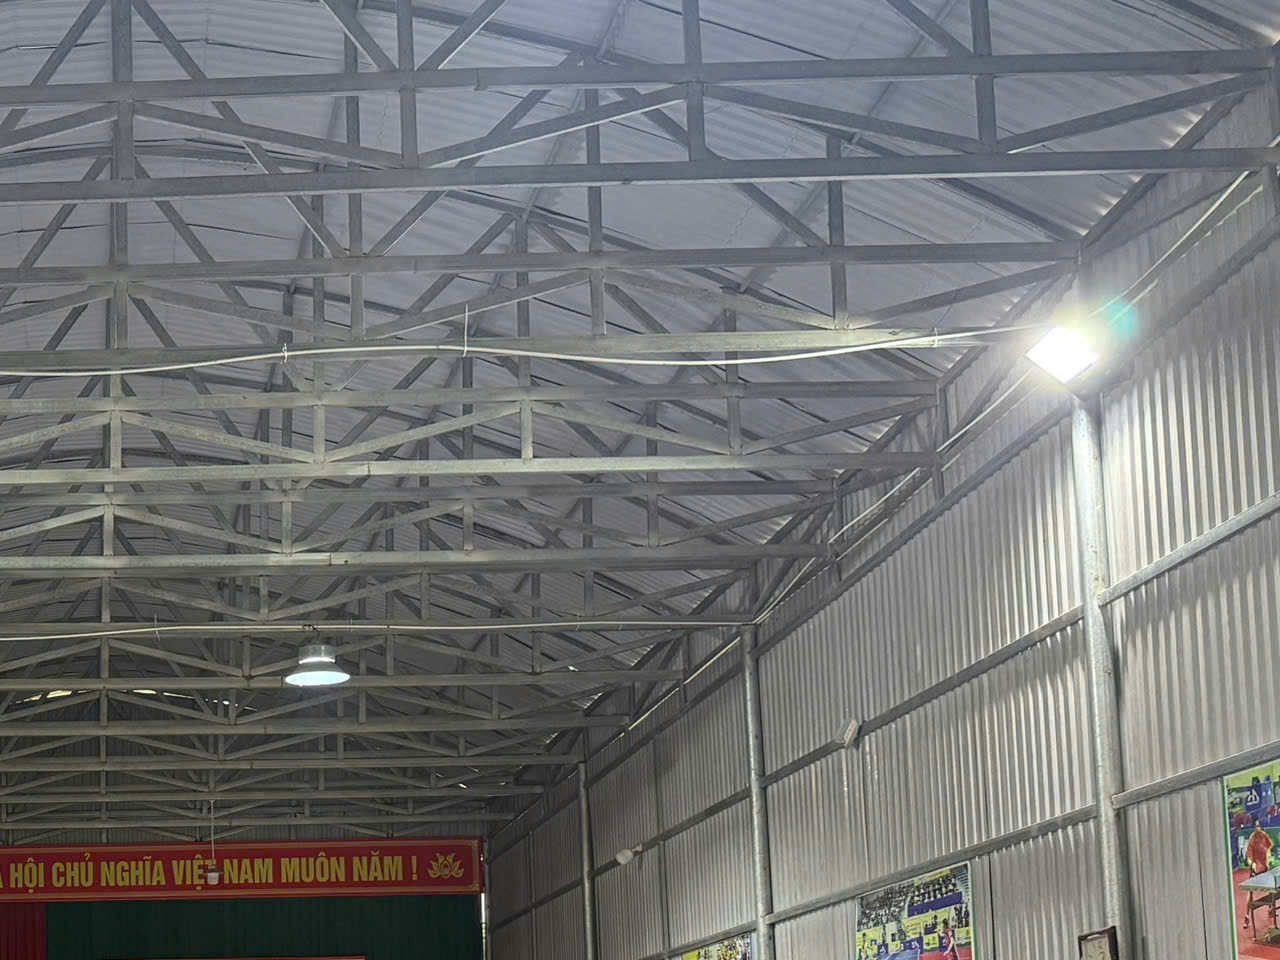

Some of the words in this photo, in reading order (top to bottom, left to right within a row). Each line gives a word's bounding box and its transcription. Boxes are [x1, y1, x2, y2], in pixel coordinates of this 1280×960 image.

[10, 857, 45, 894] HỘI
[52, 852, 94, 888] CHỦ
[100, 855, 167, 888] NGHĨA
[224, 857, 274, 884] NAM
[280, 851, 346, 883] MUÔN
[352, 850, 404, 882] NĂM
